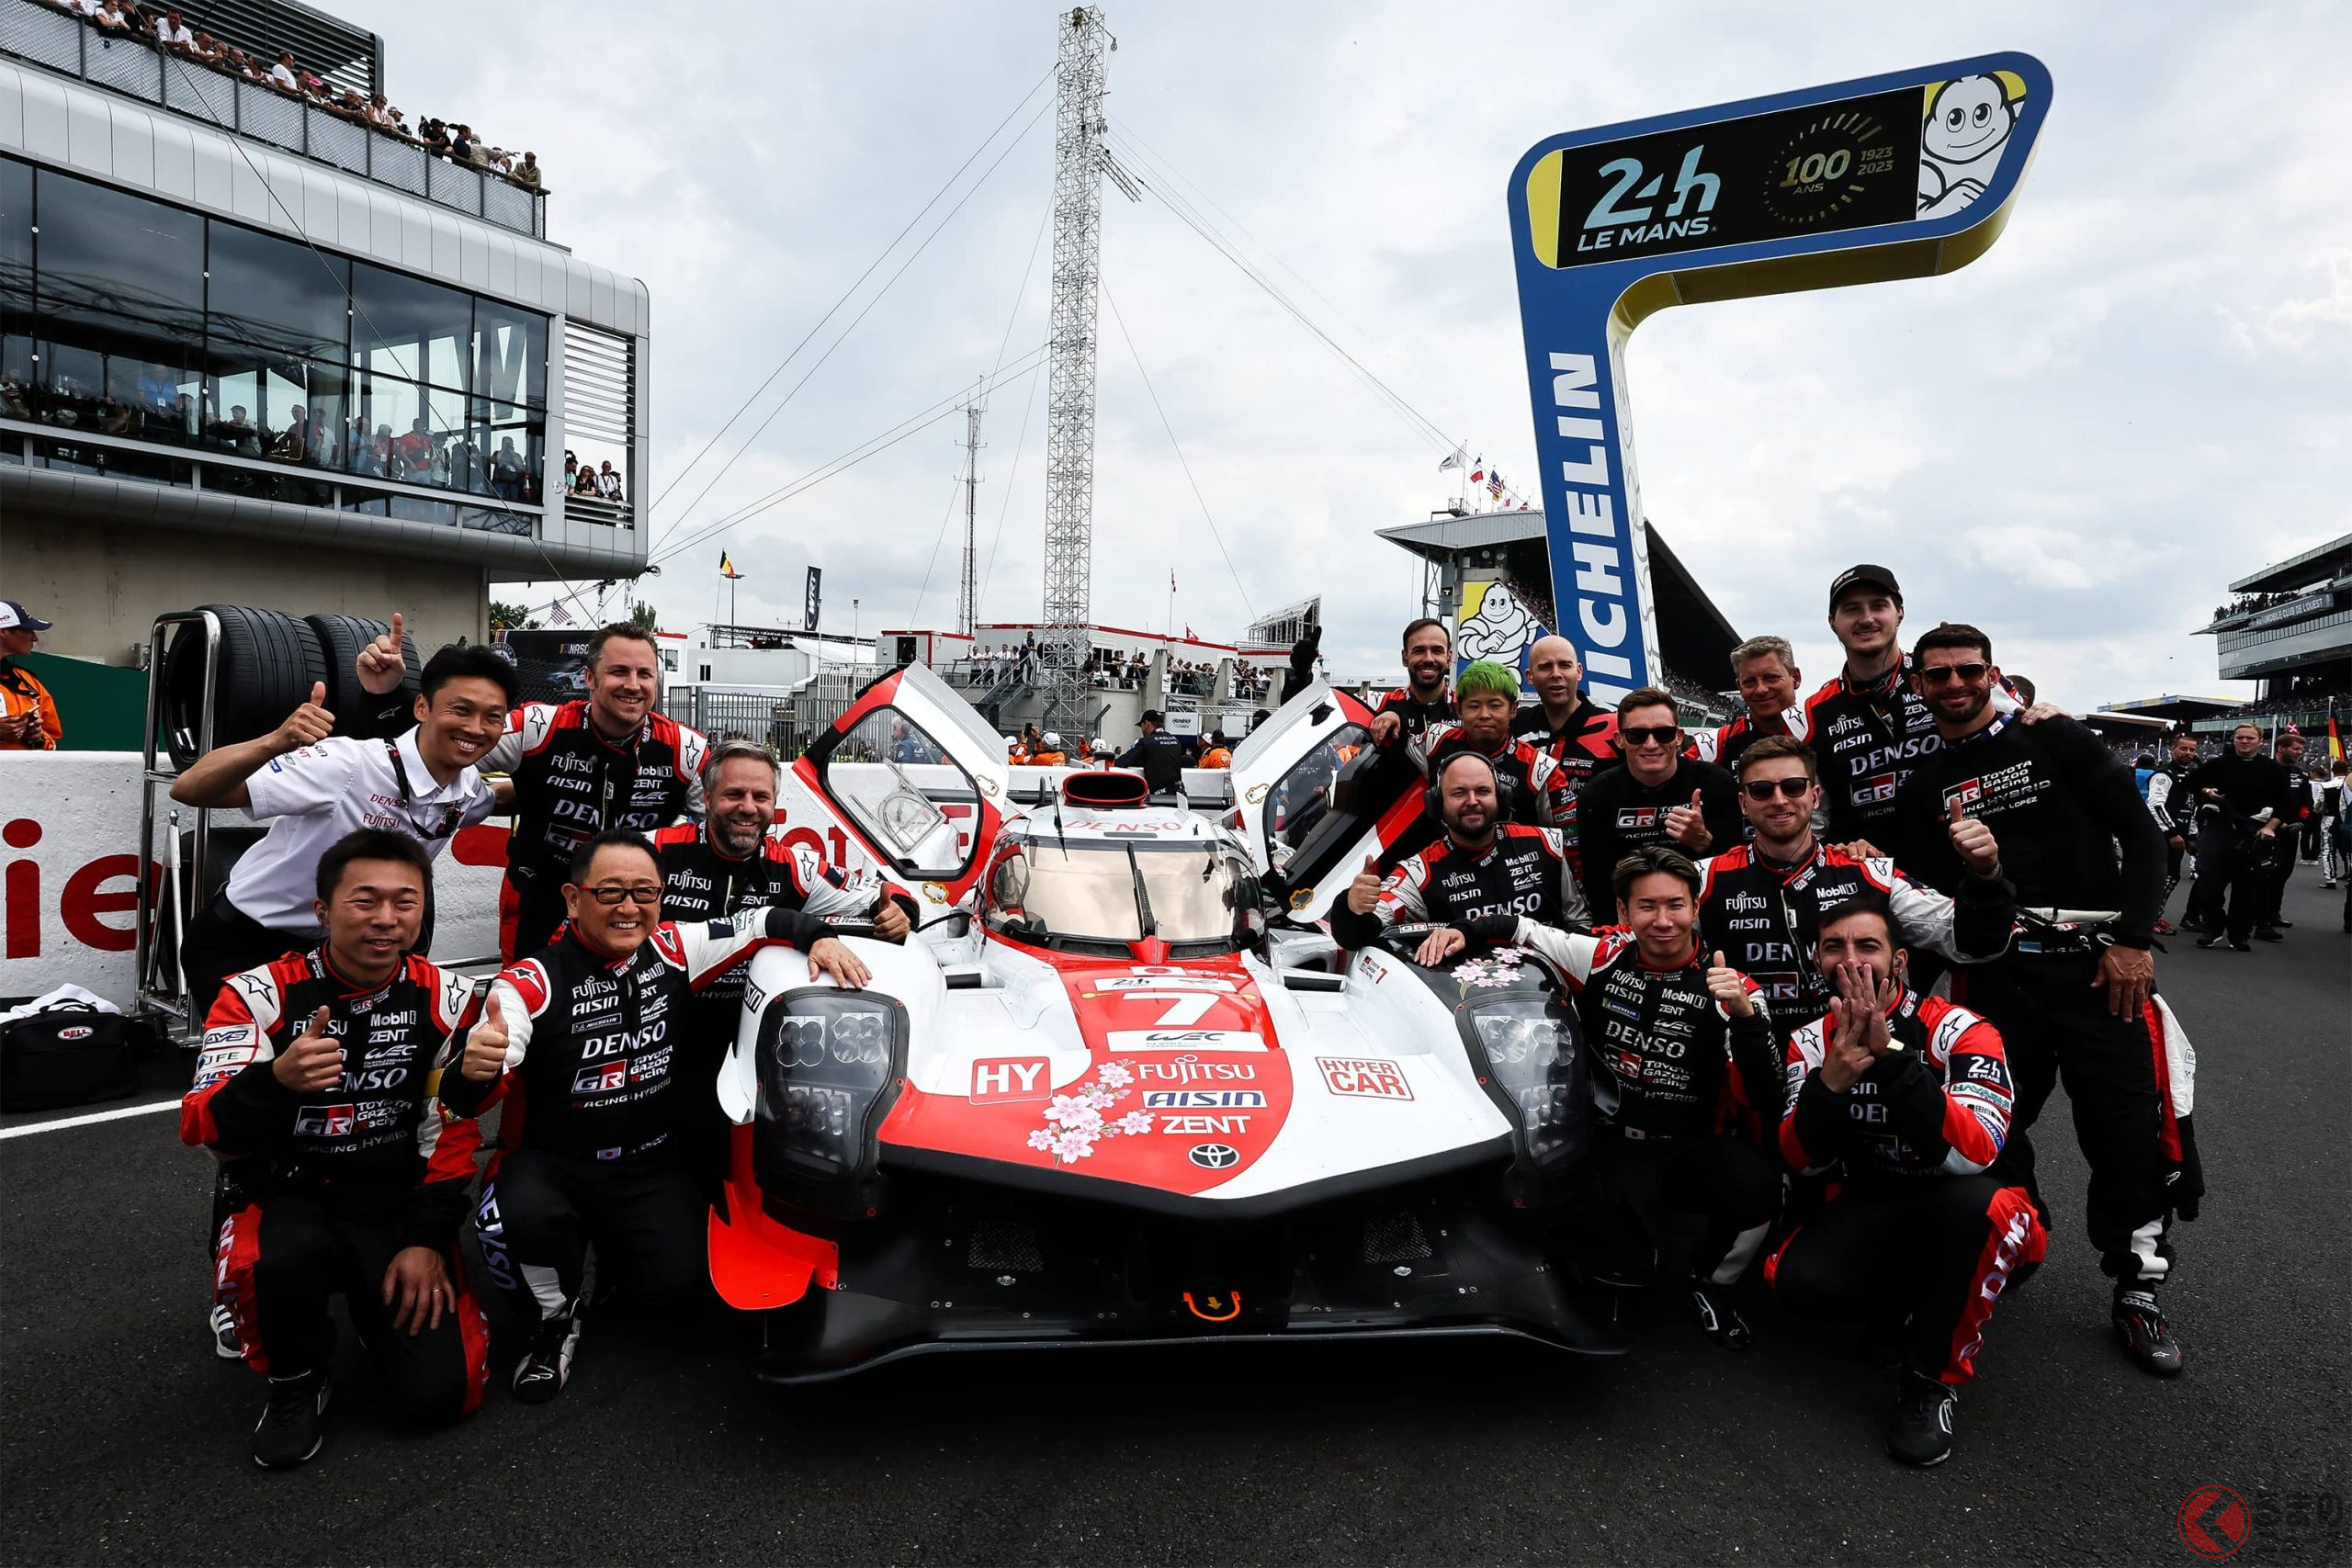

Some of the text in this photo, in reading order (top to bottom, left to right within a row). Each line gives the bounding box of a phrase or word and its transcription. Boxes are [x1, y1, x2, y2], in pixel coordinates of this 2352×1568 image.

[1860, 146, 1893, 162] 1923
[1780, 149, 1850, 188] 100
[1858, 160, 1894, 175] 2023
[1584, 144, 1722, 229] 24h
[1793, 183, 1824, 195] ANS
[1577, 217, 1710, 252] LE MANS
[1828, 715, 1865, 736] FUJITSU
[1834, 733, 1872, 752] AISIN
[551, 751, 593, 773] FUJITSU
[1850, 735, 1941, 775] DENSO
[1982, 761, 2032, 781] TOYOTA
[1983, 769, 2029, 788] GAZOO
[547, 775, 592, 792] AISIN
[633, 779, 662, 789] ZENT
[1985, 776, 2030, 795] Racing
[1987, 780, 2052, 806] HYBRID
[630, 791, 670, 800] WEC
[1853, 784, 1893, 804] GR
[363, 810, 401, 828] FUJITSU
[553, 799, 658, 829] DENSO
[1619, 816, 1654, 827] GR
[1065, 820, 1182, 832] DENSO
[667, 869, 711, 890] FUJITSU
[1442, 872, 1476, 888] FUJITSU
[741, 896, 769, 905] ZENT
[1449, 888, 1481, 902] AISIN
[1816, 885, 1846, 898] Mobil
[662, 895, 710, 910] AISIN
[1465, 893, 1542, 919] DENSO
[1725, 891, 1767, 913] FUJITSU
[1729, 919, 1770, 930] AISIN
[1375, 967, 1388, 985] 7
[1611, 969, 1646, 990] FUJITSU
[572, 976, 617, 999] FUJITSU
[1604, 983, 1644, 1004] AISIN
[572, 996, 619, 1016] AISIN
[1661, 987, 1707, 1009] Mobil 1
[1123, 991, 1220, 1026] 7
[1611, 1003, 1637, 1016] MICHELIN
[1658, 1003, 1685, 1017] ZENT
[370, 1010, 408, 1027] Mobil
[1654, 1018, 1696, 1032] WEC
[62, 1029, 89, 1037] BELL
[368, 1029, 409, 1043] ZENT
[582, 1021, 666, 1059] DENSO
[1146, 1032, 1225, 1042] WEC
[1605, 1020, 1686, 1058] DENSO
[365, 1044, 417, 1059] WEC
[634, 1045, 673, 1066] TOYOTA
[630, 1055, 670, 1075] GAZOO
[630, 1066, 668, 1083] Racing
[1137, 1055, 1256, 1085] FUJITSU
[1322, 1060, 1396, 1075] HYPER
[1643, 1068, 1690, 1080] GAZOO
[1968, 1056, 2001, 1077] 24h
[325, 1067, 407, 1092] NSO
[574, 1071, 623, 1092] GR
[976, 1063, 1045, 1095] HY
[1330, 1072, 1406, 1096] CAR
[1643, 1076, 1688, 1089] Racing
[1980, 1073, 2000, 1084] MANS
[634, 1077, 671, 1100] HYBRID
[1645, 1090, 1698, 1102] HYBRID
[572, 1095, 628, 1108] RACING
[1148, 1092, 1261, 1106] AISIN
[298, 1117, 351, 1134] GR
[1160, 1115, 1250, 1134] ZENT
